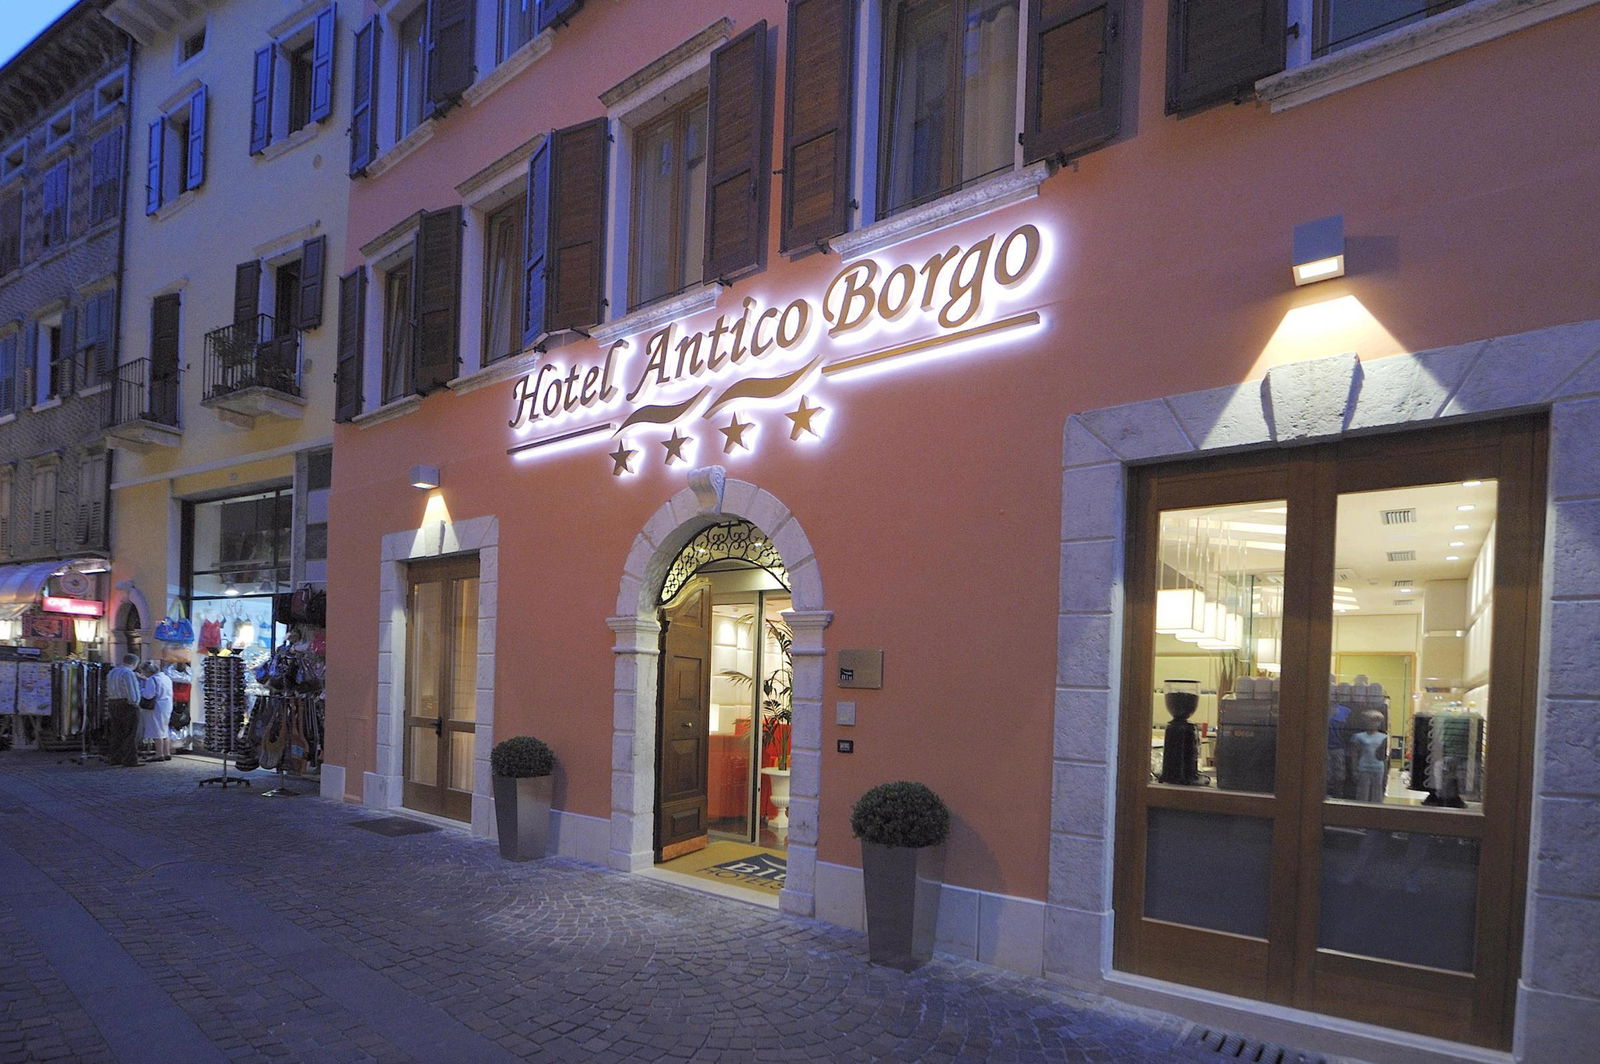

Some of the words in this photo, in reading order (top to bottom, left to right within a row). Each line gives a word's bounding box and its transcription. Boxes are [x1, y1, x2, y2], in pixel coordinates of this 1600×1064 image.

[508, 339, 629, 428] Hotel
[626, 296, 808, 401] Antico
[822, 223, 1041, 335] Borgo
